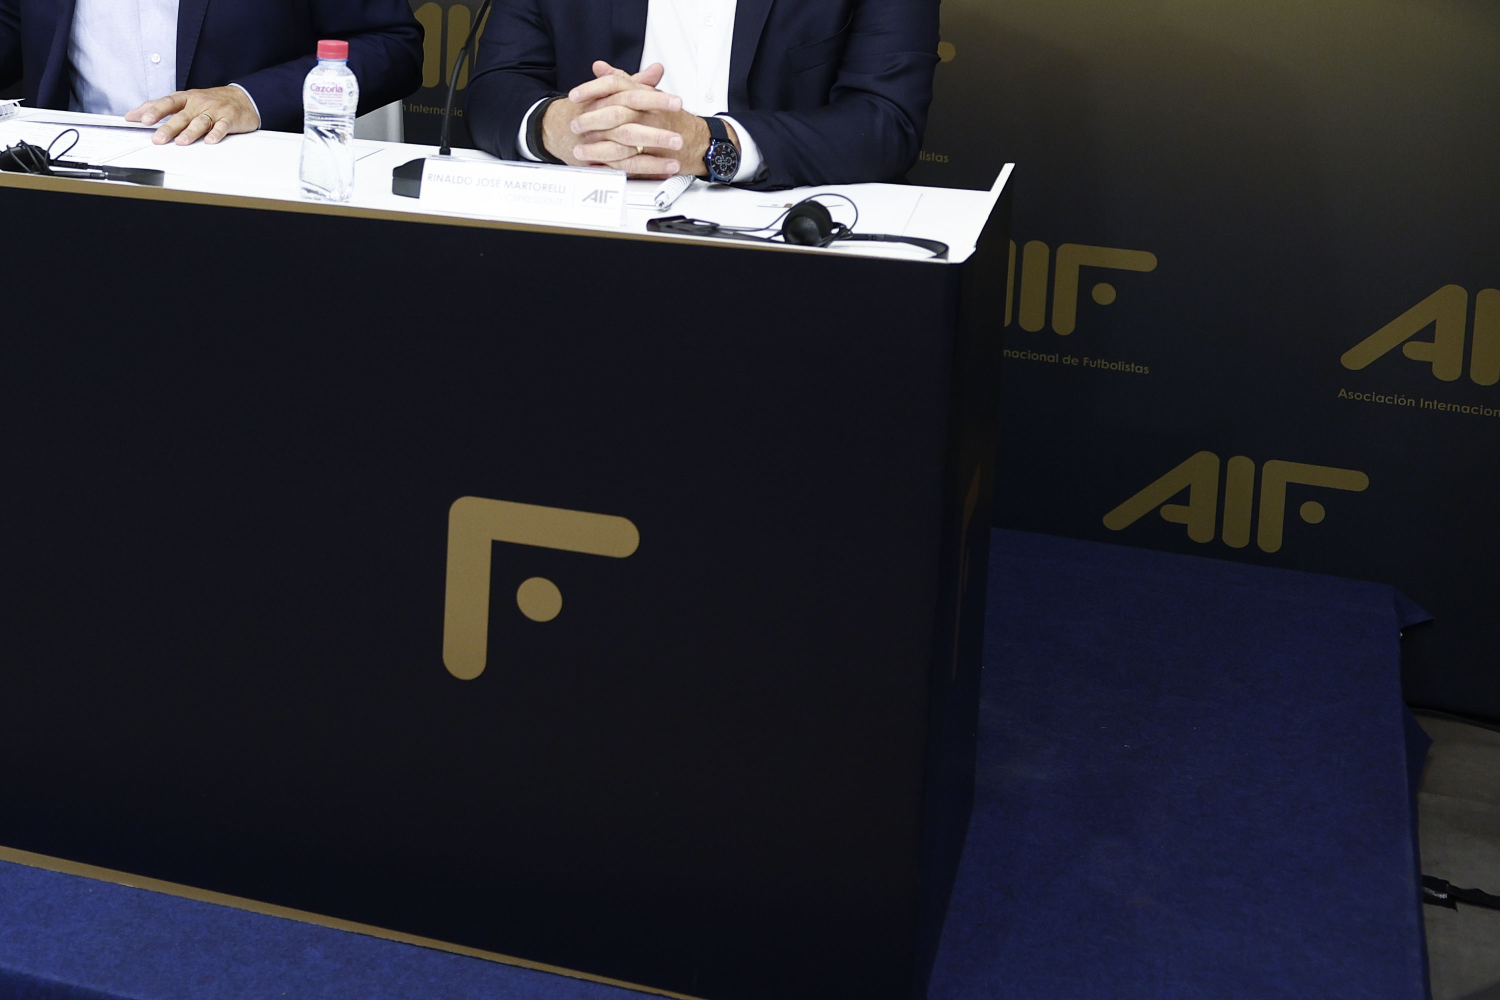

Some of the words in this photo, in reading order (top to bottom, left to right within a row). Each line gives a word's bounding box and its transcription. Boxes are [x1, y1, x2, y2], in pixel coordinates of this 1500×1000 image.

[310, 82, 344, 93] Cazorla
[919, 150, 950, 164] listas
[427, 172, 473, 186] RINALDO
[476, 175, 501, 189] JOSÉ
[503, 179, 567, 195] MARTORELLI
[582, 189, 619, 204] AIF
[1004, 239, 1158, 336] IF
[1340, 284, 1500, 386] AI
[1003, 349, 1060, 364] nacional
[1062, 355, 1080, 366] de
[1083, 357, 1150, 375] Futbolistas
[1338, 388, 1415, 407] Asociación
[1102, 450, 1370, 554] AIF
